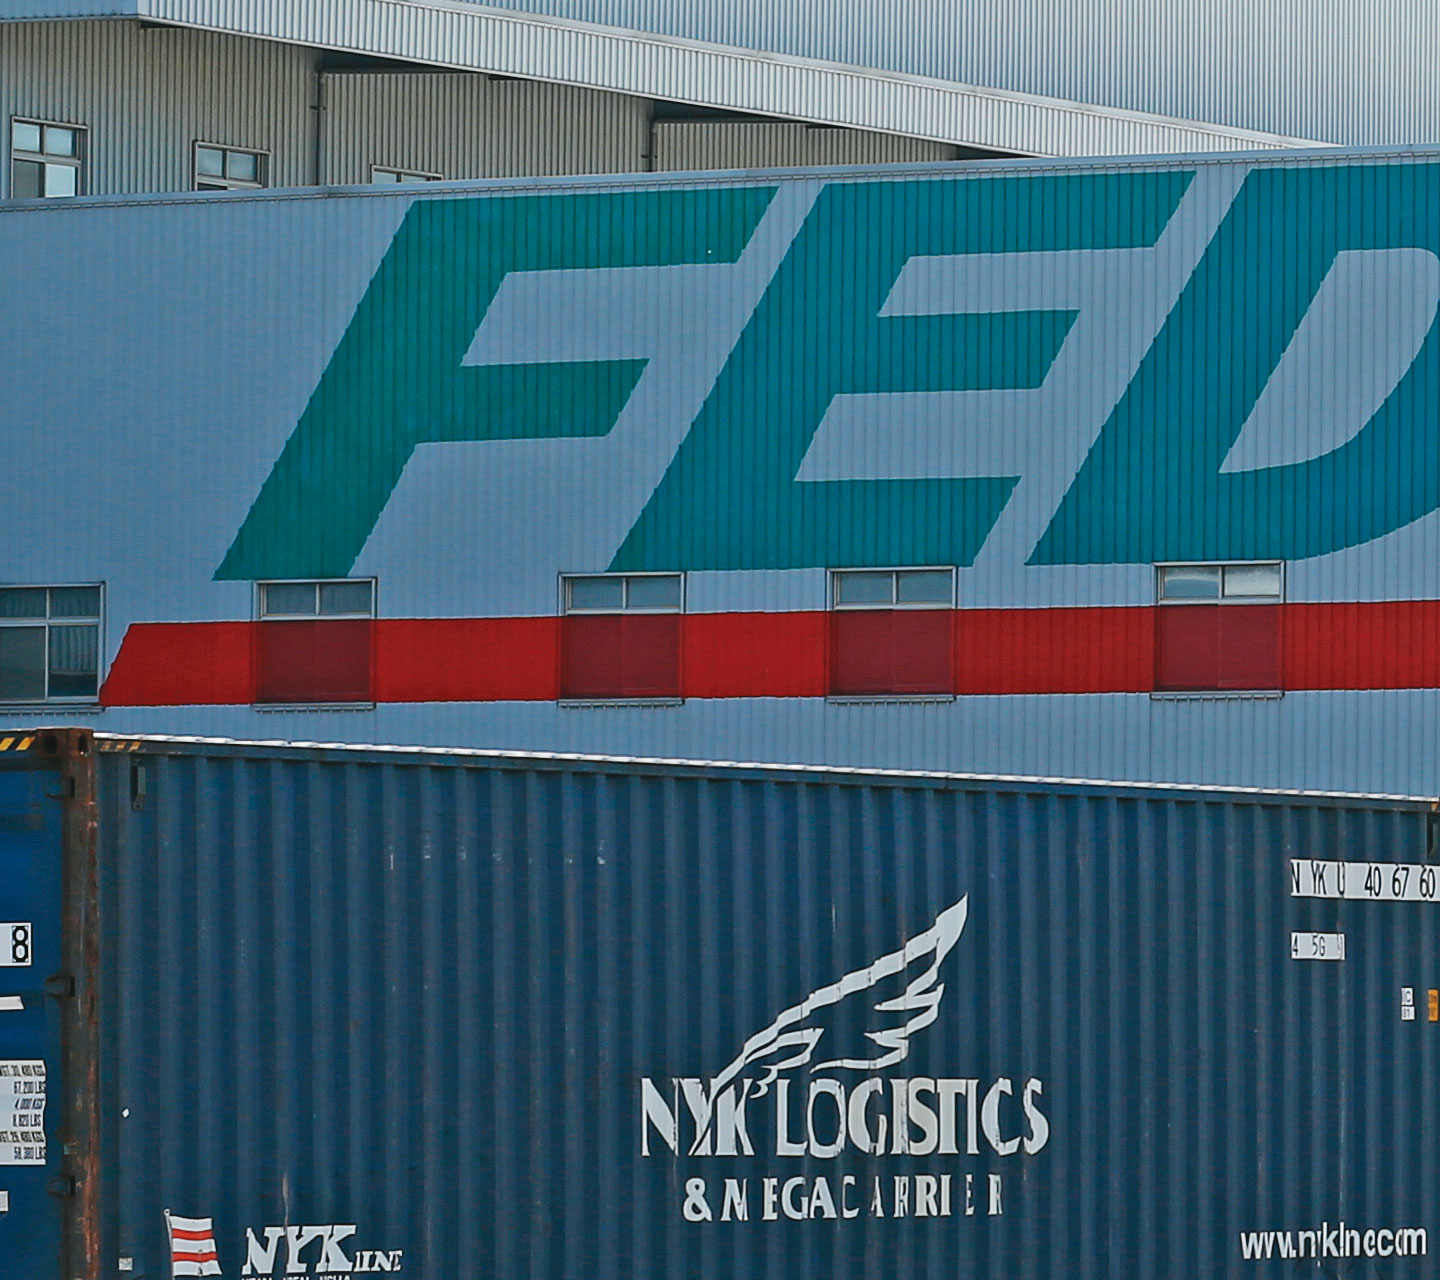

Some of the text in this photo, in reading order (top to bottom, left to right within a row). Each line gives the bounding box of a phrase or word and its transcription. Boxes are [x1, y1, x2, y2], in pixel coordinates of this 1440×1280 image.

[12, 925, 29, 963] 8
[641, 1076, 1050, 1158] NYK LOGISTICS
[683, 1177, 713, 1222] &
[242, 1225, 356, 1275] NYK
